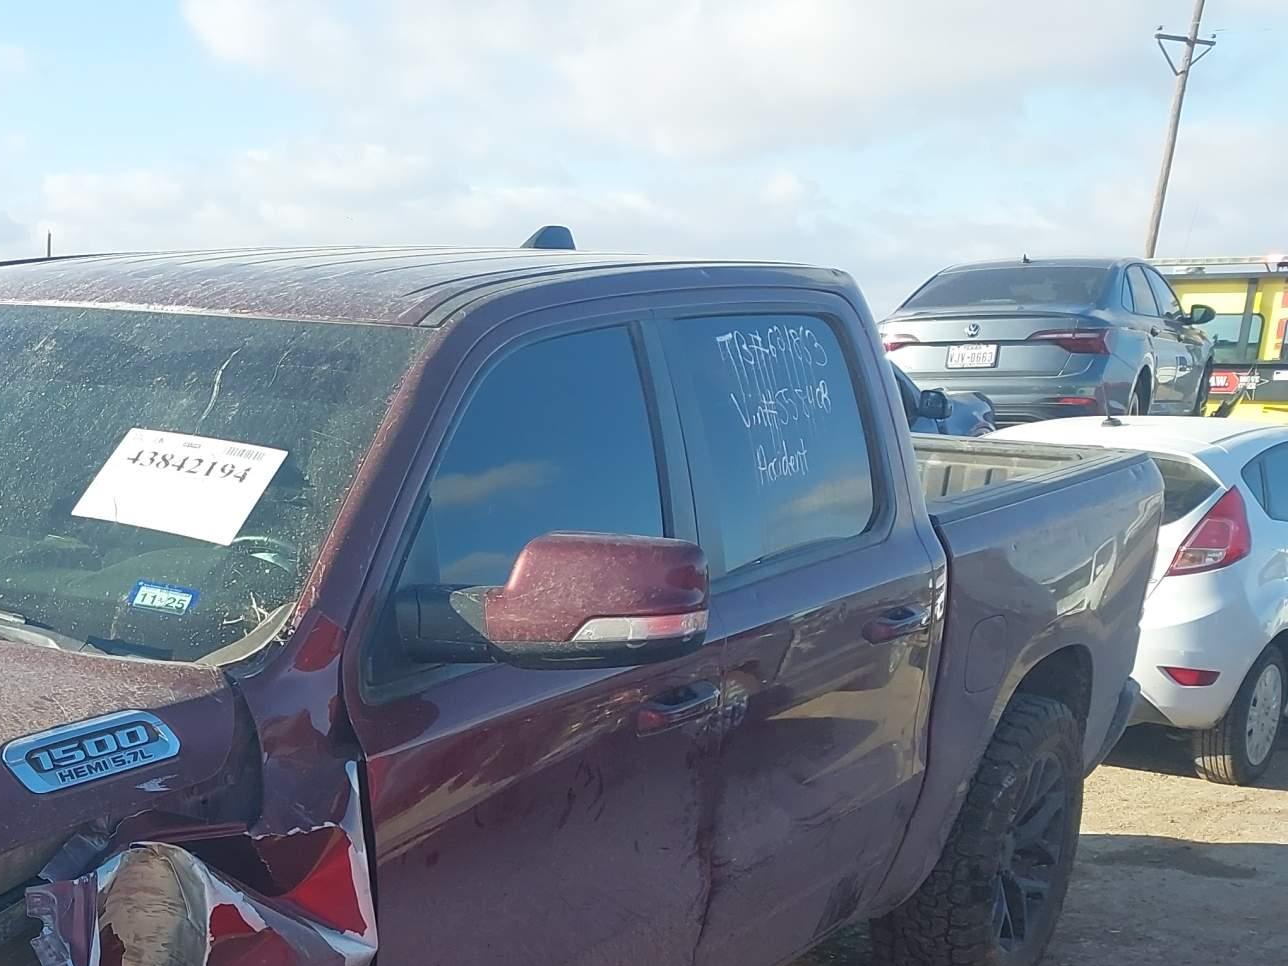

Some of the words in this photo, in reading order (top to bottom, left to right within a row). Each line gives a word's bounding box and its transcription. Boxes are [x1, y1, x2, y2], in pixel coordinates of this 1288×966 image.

[126, 450, 253, 483] 43842194
[140, 592, 157, 605] 11
[164, 596, 187, 610] 25
[31, 725, 149, 771] 1500
[57, 759, 110, 784] HEMI
[111, 749, 154, 767] 5.7L
